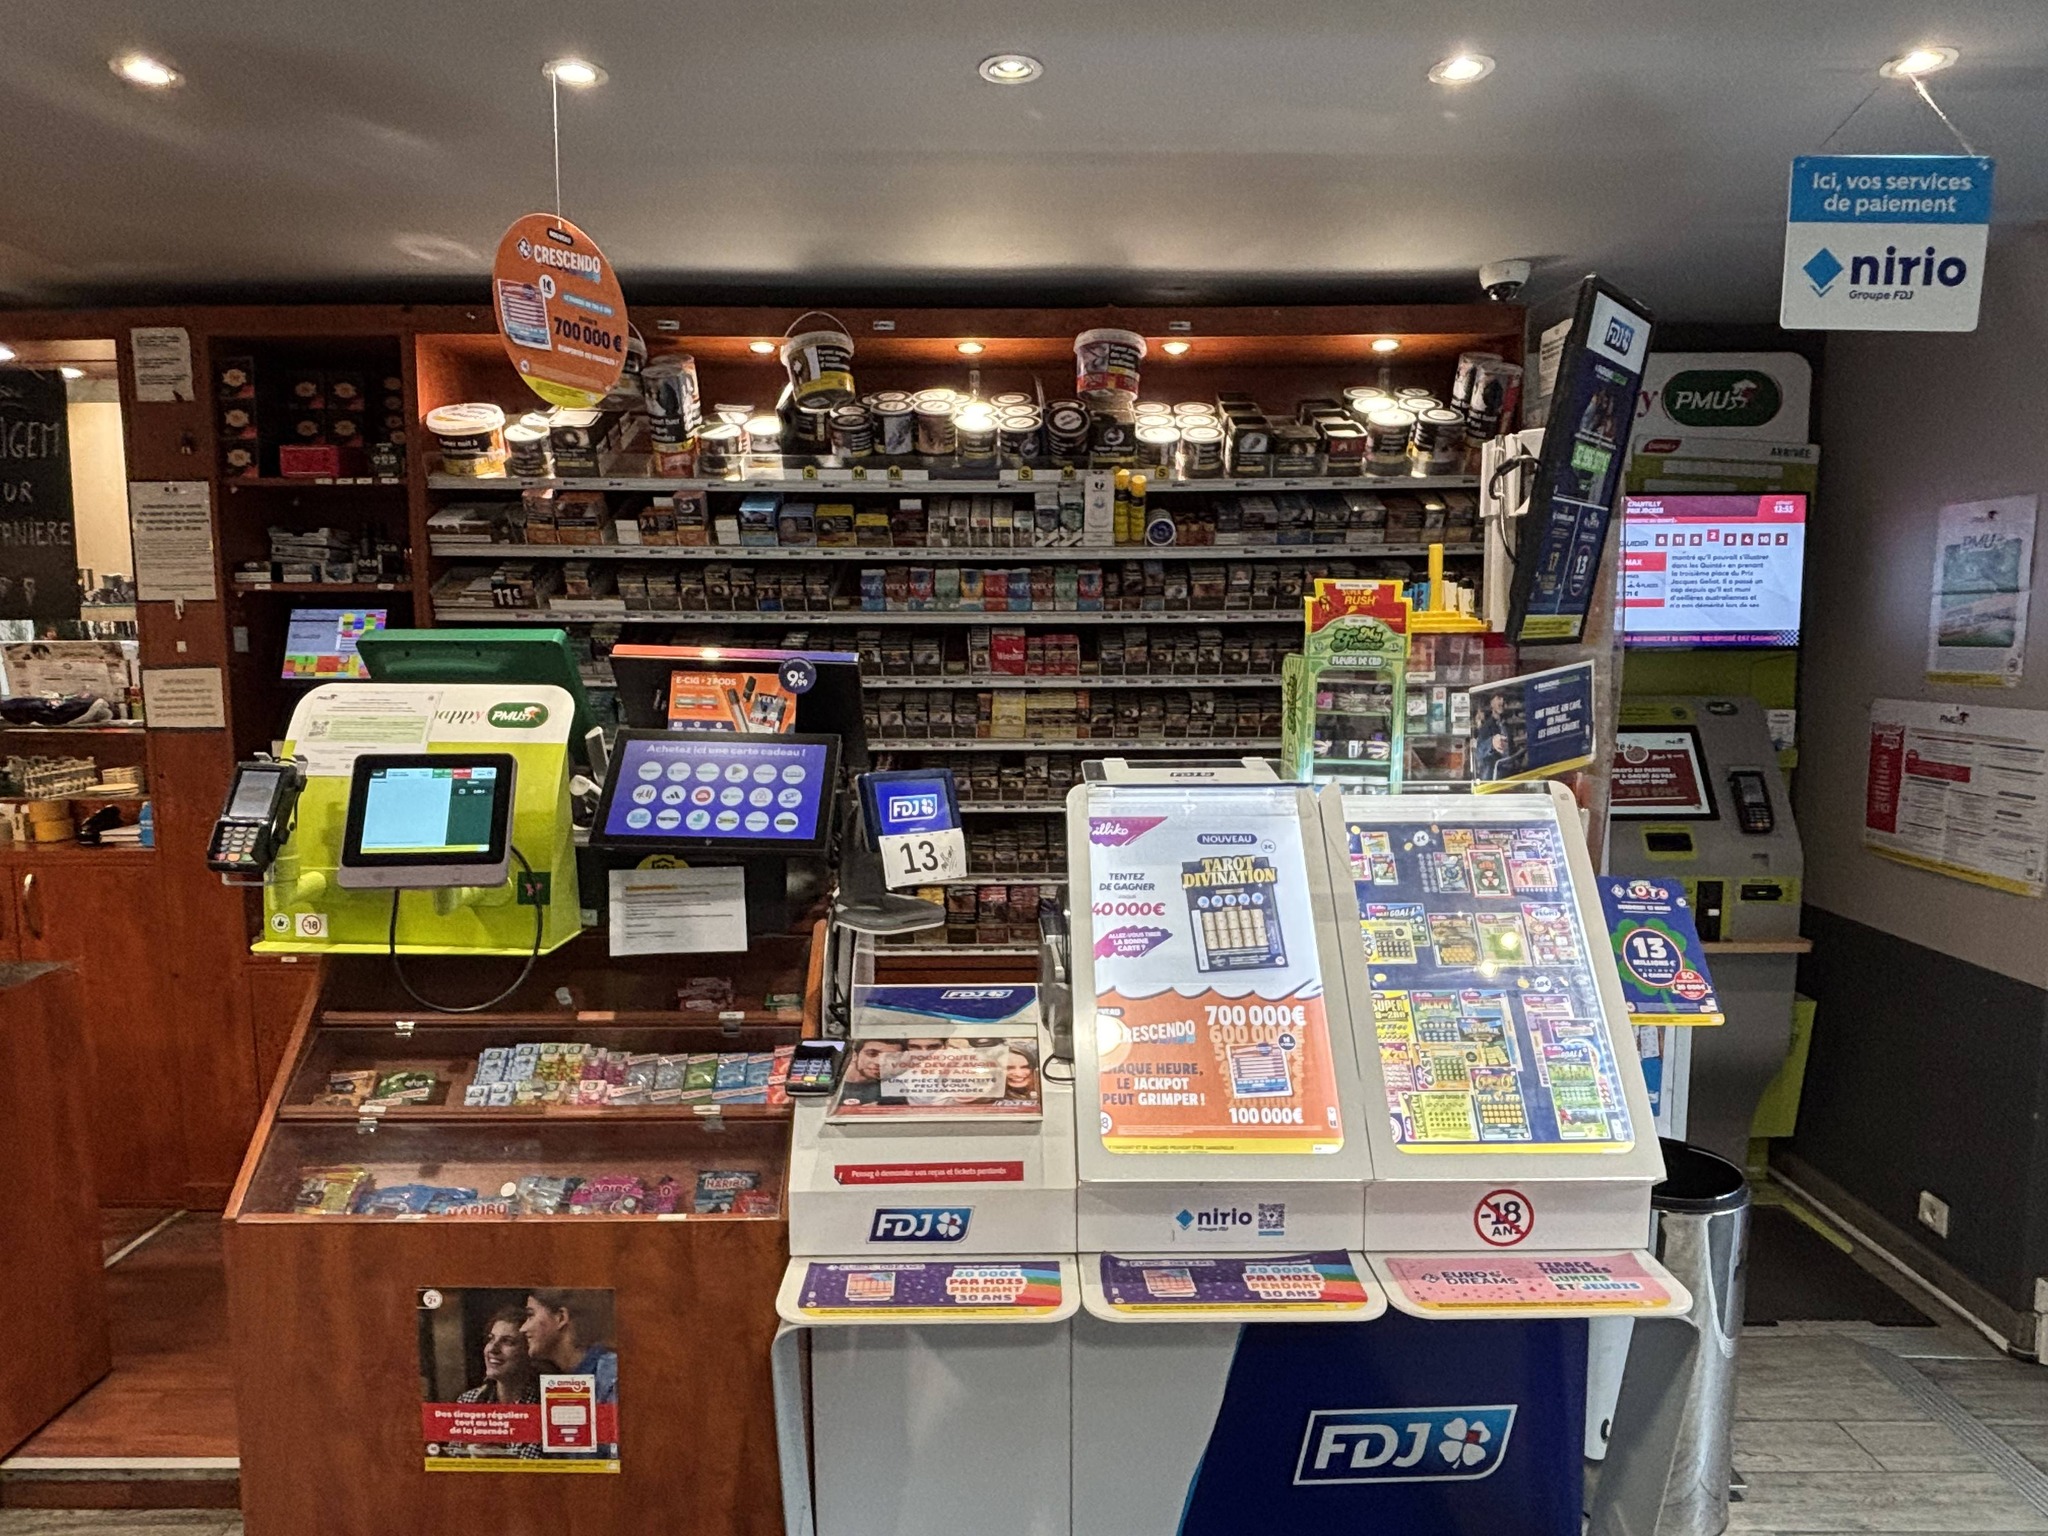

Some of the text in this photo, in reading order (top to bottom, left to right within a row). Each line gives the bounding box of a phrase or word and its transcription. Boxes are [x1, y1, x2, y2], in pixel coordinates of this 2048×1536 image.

[1813, 172, 1972, 191] Ici, vos services
[1823, 195, 1957, 216] de paiement
[532, 244, 601, 275] CRESCENDO
[1850, 246, 1967, 287] nirio
[1849, 290, 1914, 301] Groupe FDJ
[553, 315, 622, 352] 700 000 €
[1675, 390, 1728, 410] PMU
[1345, 596, 1376, 605] RUSH
[1332, 656, 1382, 665] FLEURS DE CBD
[713, 678, 737, 686] PODS
[434, 708, 526, 724] appy PMU
[647, 744, 799, 756] Achetez ici une carte cadeau
[893, 800, 919, 817] FDJ
[1092, 822, 1129, 836] illiko
[1202, 834, 1252, 844] NOUVEAU
[900, 840, 938, 874] 13
[1202, 856, 1255, 873] TAROT
[1109, 872, 1145, 881] TENTEZ
[1182, 867, 1277, 887] DIVINATION
[1099, 882, 1155, 891] DE GAGNER
[1626, 885, 1669, 900] LOTO
[1092, 902, 1166, 916] 40 000€
[1633, 937, 1667, 959] 13
[1536, 980, 1550, 988] 10€
[1372, 999, 1404, 1011] SUPER
[1205, 1005, 1306, 1026] 700 000€
[1209, 1025, 1249, 1043] 600
[1156, 1062, 1203, 1076] HEURE,
[1117, 1078, 1188, 1090] LE JACKPOT
[1102, 1093, 1199, 1106] PEUT GRIMPER
[1229, 1107, 1305, 1124] 100 000€
[852, 1170, 874, 1179] Pensez
[881, 1169, 914, 1177] demander
[706, 1178, 748, 1190] HARIBO
[1198, 1207, 1252, 1225] nirio
[1480, 1201, 1522, 1226] -18
[876, 1213, 933, 1237] FDJ
[1492, 1226, 1521, 1237] ANS
[1442, 1271, 1488, 1279] EURO
[1583, 1266, 1611, 1274] LES
[1282, 1274, 1321, 1282] MOIS
[1446, 1276, 1519, 1286] DREAMS
[1251, 1282, 1322, 1290] PENDANT
[1555, 1282, 1640, 1291] ET JEUDIS
[1263, 1290, 1317, 1298] 30 ANS
[557, 1378, 587, 1392] amigo
[435, 1409, 529, 1420] Des tirages réguliers
[454, 1418, 509, 1429] tout au long
[449, 1425, 511, 1437] de la journée
[1314, 1421, 1433, 1470] FDJ
